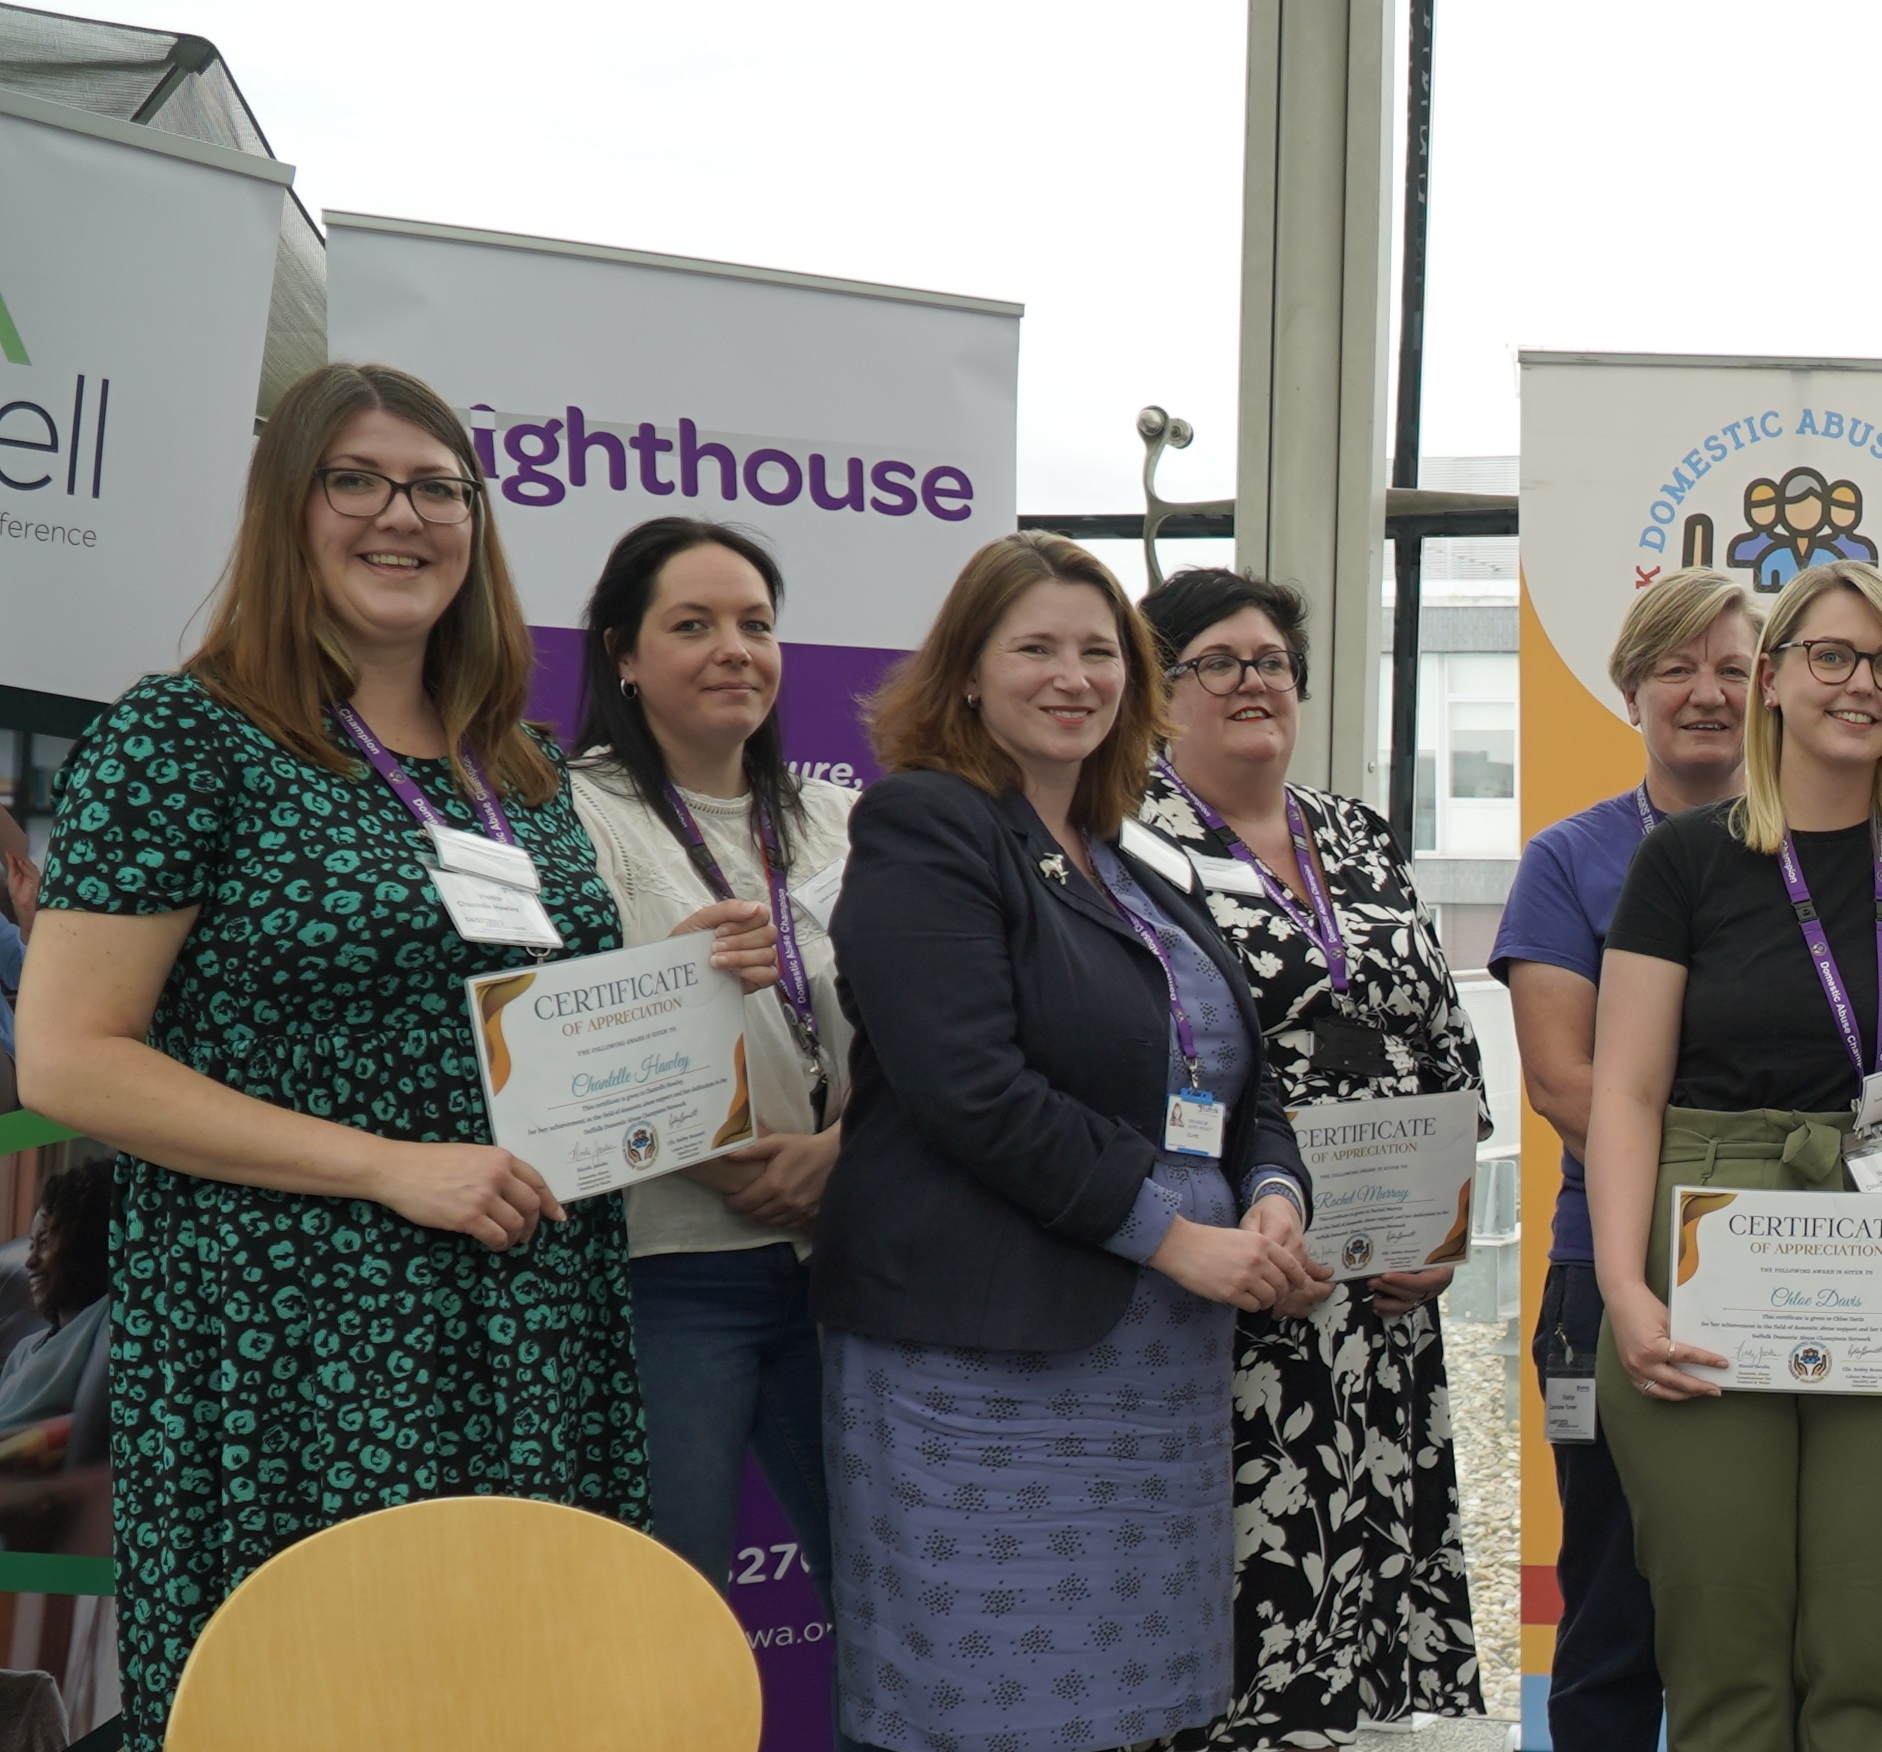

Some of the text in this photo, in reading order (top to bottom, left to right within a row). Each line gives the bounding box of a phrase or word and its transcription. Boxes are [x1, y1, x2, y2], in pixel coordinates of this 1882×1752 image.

[1639, 410, 1783, 554] DOMESTIC
[339, 707, 380, 756] Champion
[534, 962, 698, 1021] CERTIFICATE
[789, 960, 806, 1004] Domestic
[1820, 960, 1842, 1003] Domestic
[1836, 1003, 1852, 1034] Abuse
[562, 997, 683, 1037] OF APPRECIATION
[1311, 1142, 1418, 1164] OF APPRECIATION
[1750, 1242, 1771, 1254] OF
[1771, 1287, 1863, 1308] Chloe Davis
